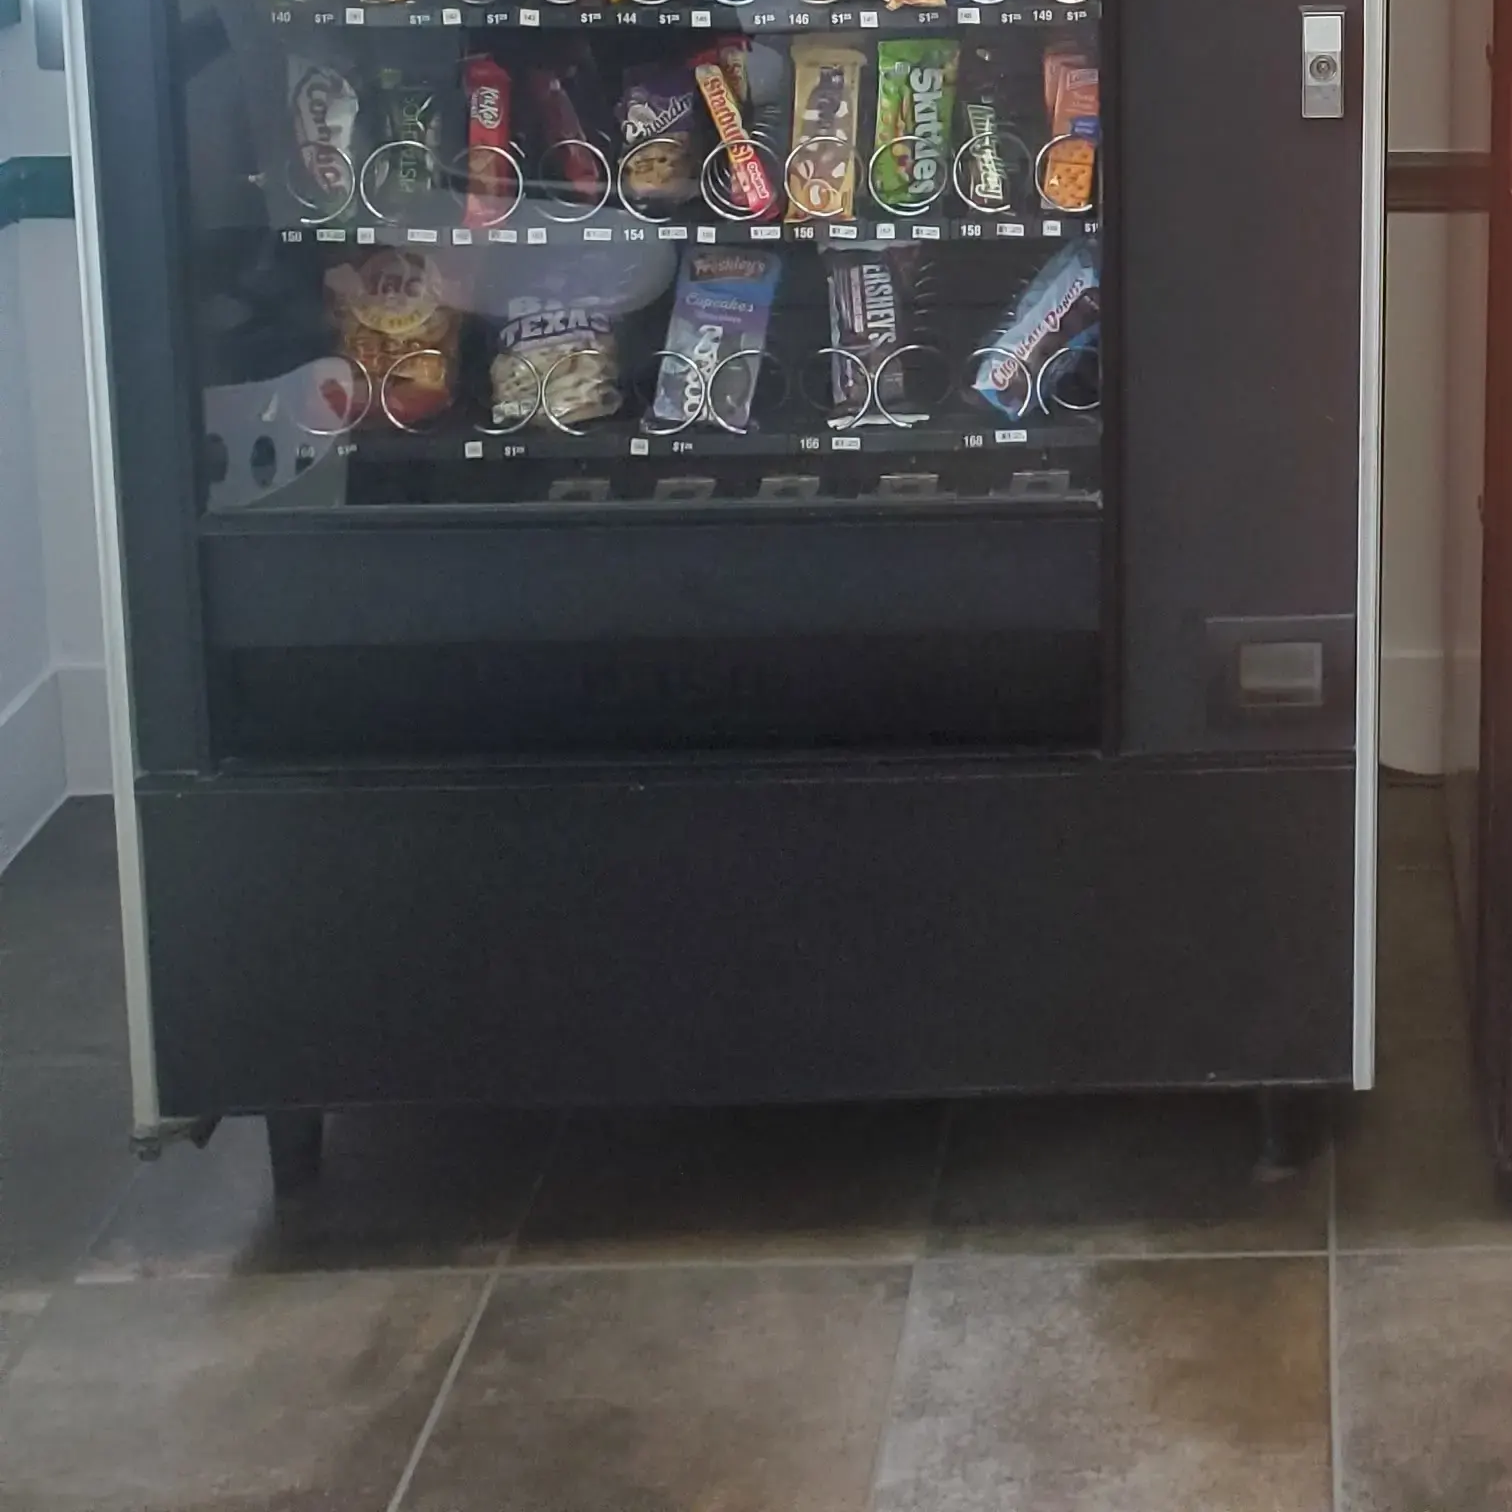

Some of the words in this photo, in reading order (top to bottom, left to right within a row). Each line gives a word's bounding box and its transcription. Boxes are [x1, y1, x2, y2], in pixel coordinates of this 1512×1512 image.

[616, 13, 637, 24] 144
[789, 14, 810, 25] 146
[1033, 11, 1053, 22] 149
[909, 68, 943, 194] Skittles
[624, 230, 644, 241] 154
[793, 228, 813, 239] 156
[961, 225, 981, 236] 158
[282, 231, 302, 242] 150
[685, 292, 753, 313] Cupcakes
[800, 438, 819, 449] 166
[963, 435, 983, 447] 168
